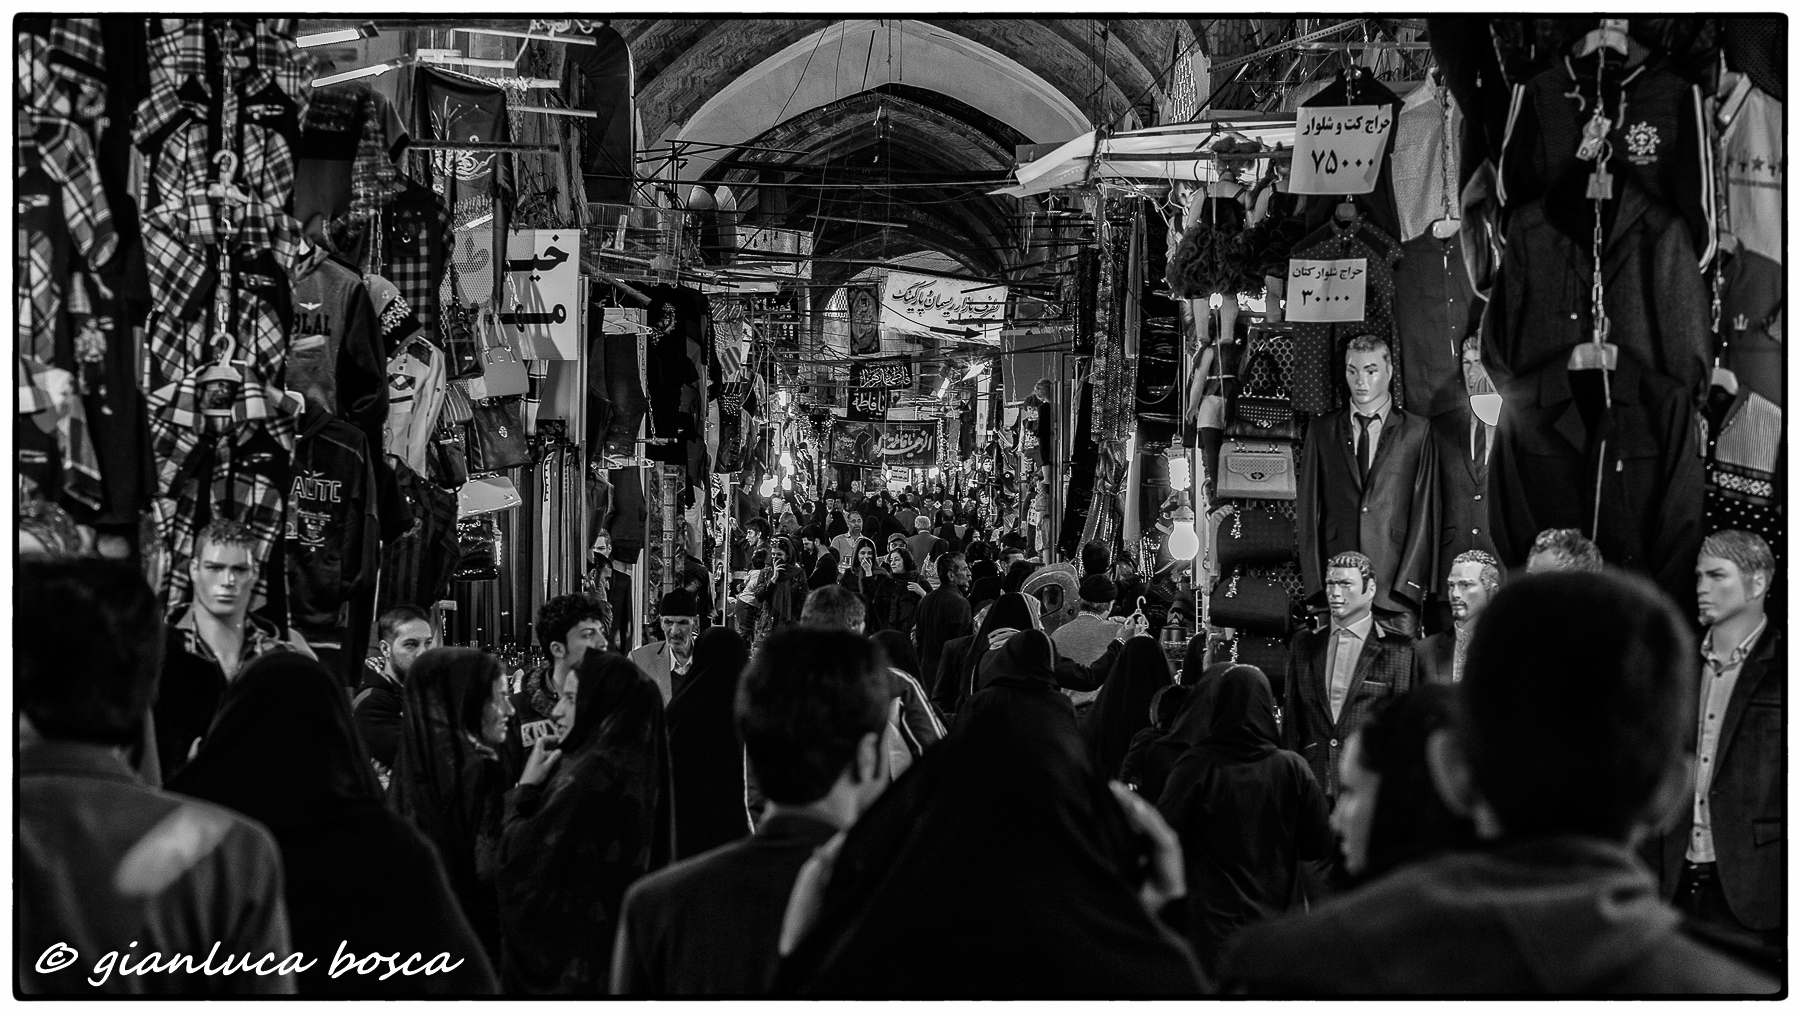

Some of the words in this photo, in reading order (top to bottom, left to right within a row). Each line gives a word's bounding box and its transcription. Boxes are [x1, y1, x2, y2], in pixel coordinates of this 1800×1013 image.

[1302, 116, 1334, 136] شلوار
[1335, 121, 1342, 135] و
[1344, 115, 1364, 130] کت
[1365, 114, 1390, 134] حراج
[1311, 149, 1374, 174] ۷۵۰۰۰
[1292, 266, 1316, 278] کتان
[1315, 267, 1338, 281] شلوار
[1339, 266, 1363, 280] حراج
[1302, 289, 1349, 306] ۳۰۰۰۰
